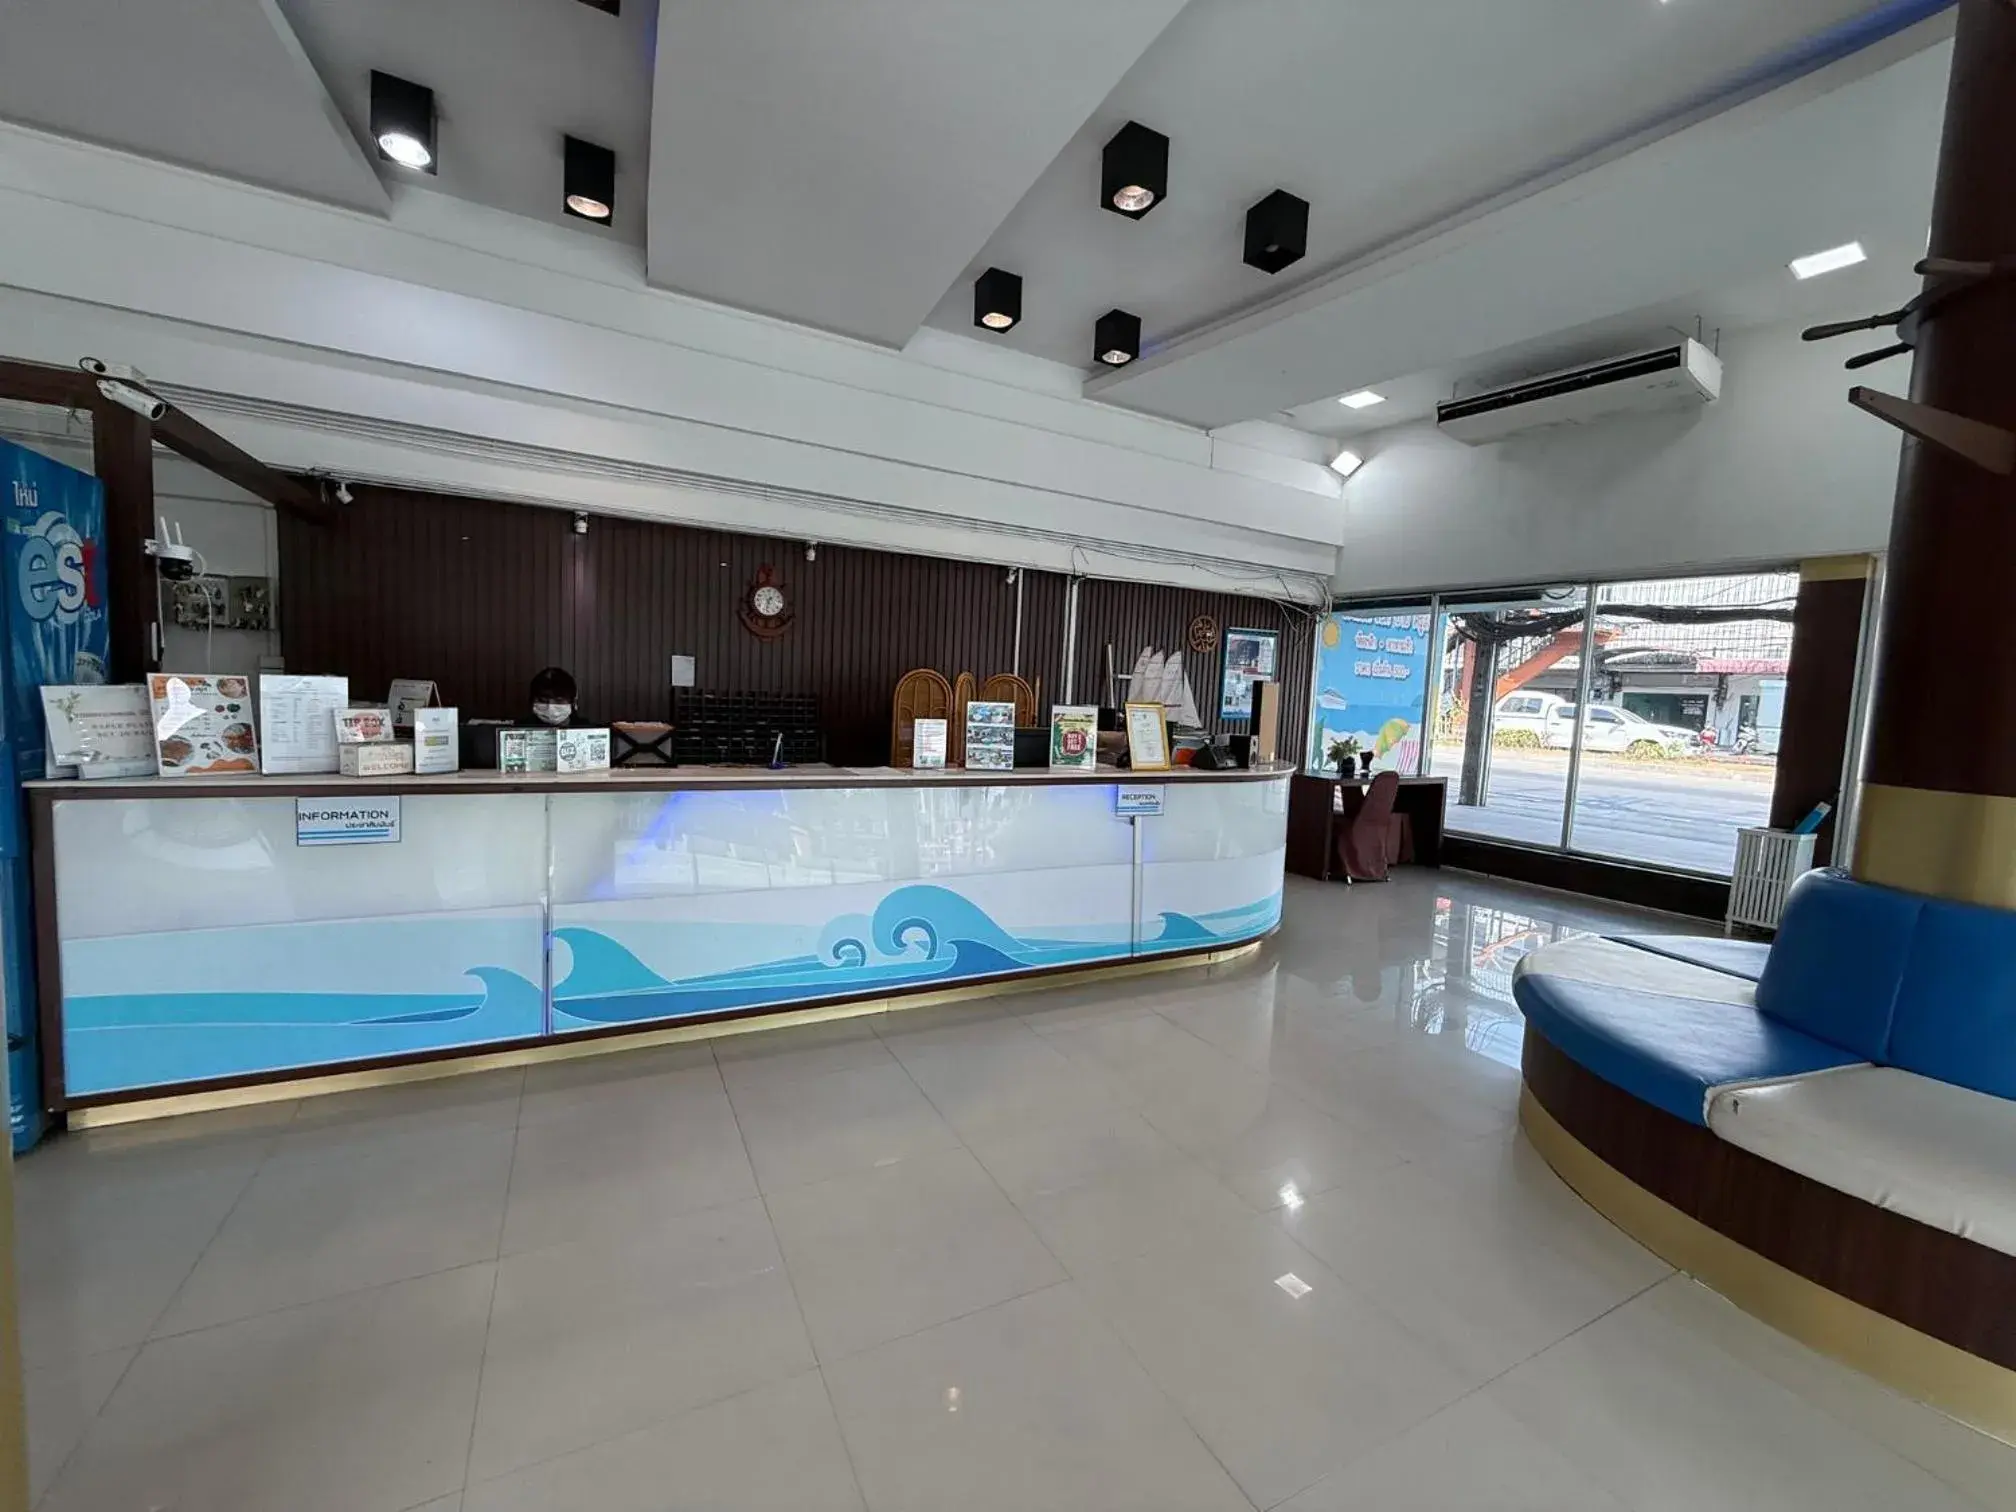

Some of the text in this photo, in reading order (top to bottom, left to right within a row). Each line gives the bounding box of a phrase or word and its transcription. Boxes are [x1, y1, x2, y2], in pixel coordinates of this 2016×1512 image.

[18, 536, 99, 622] est
[1121, 793, 1156, 801] RECEPTION
[299, 810, 389, 821] INFORMATION
